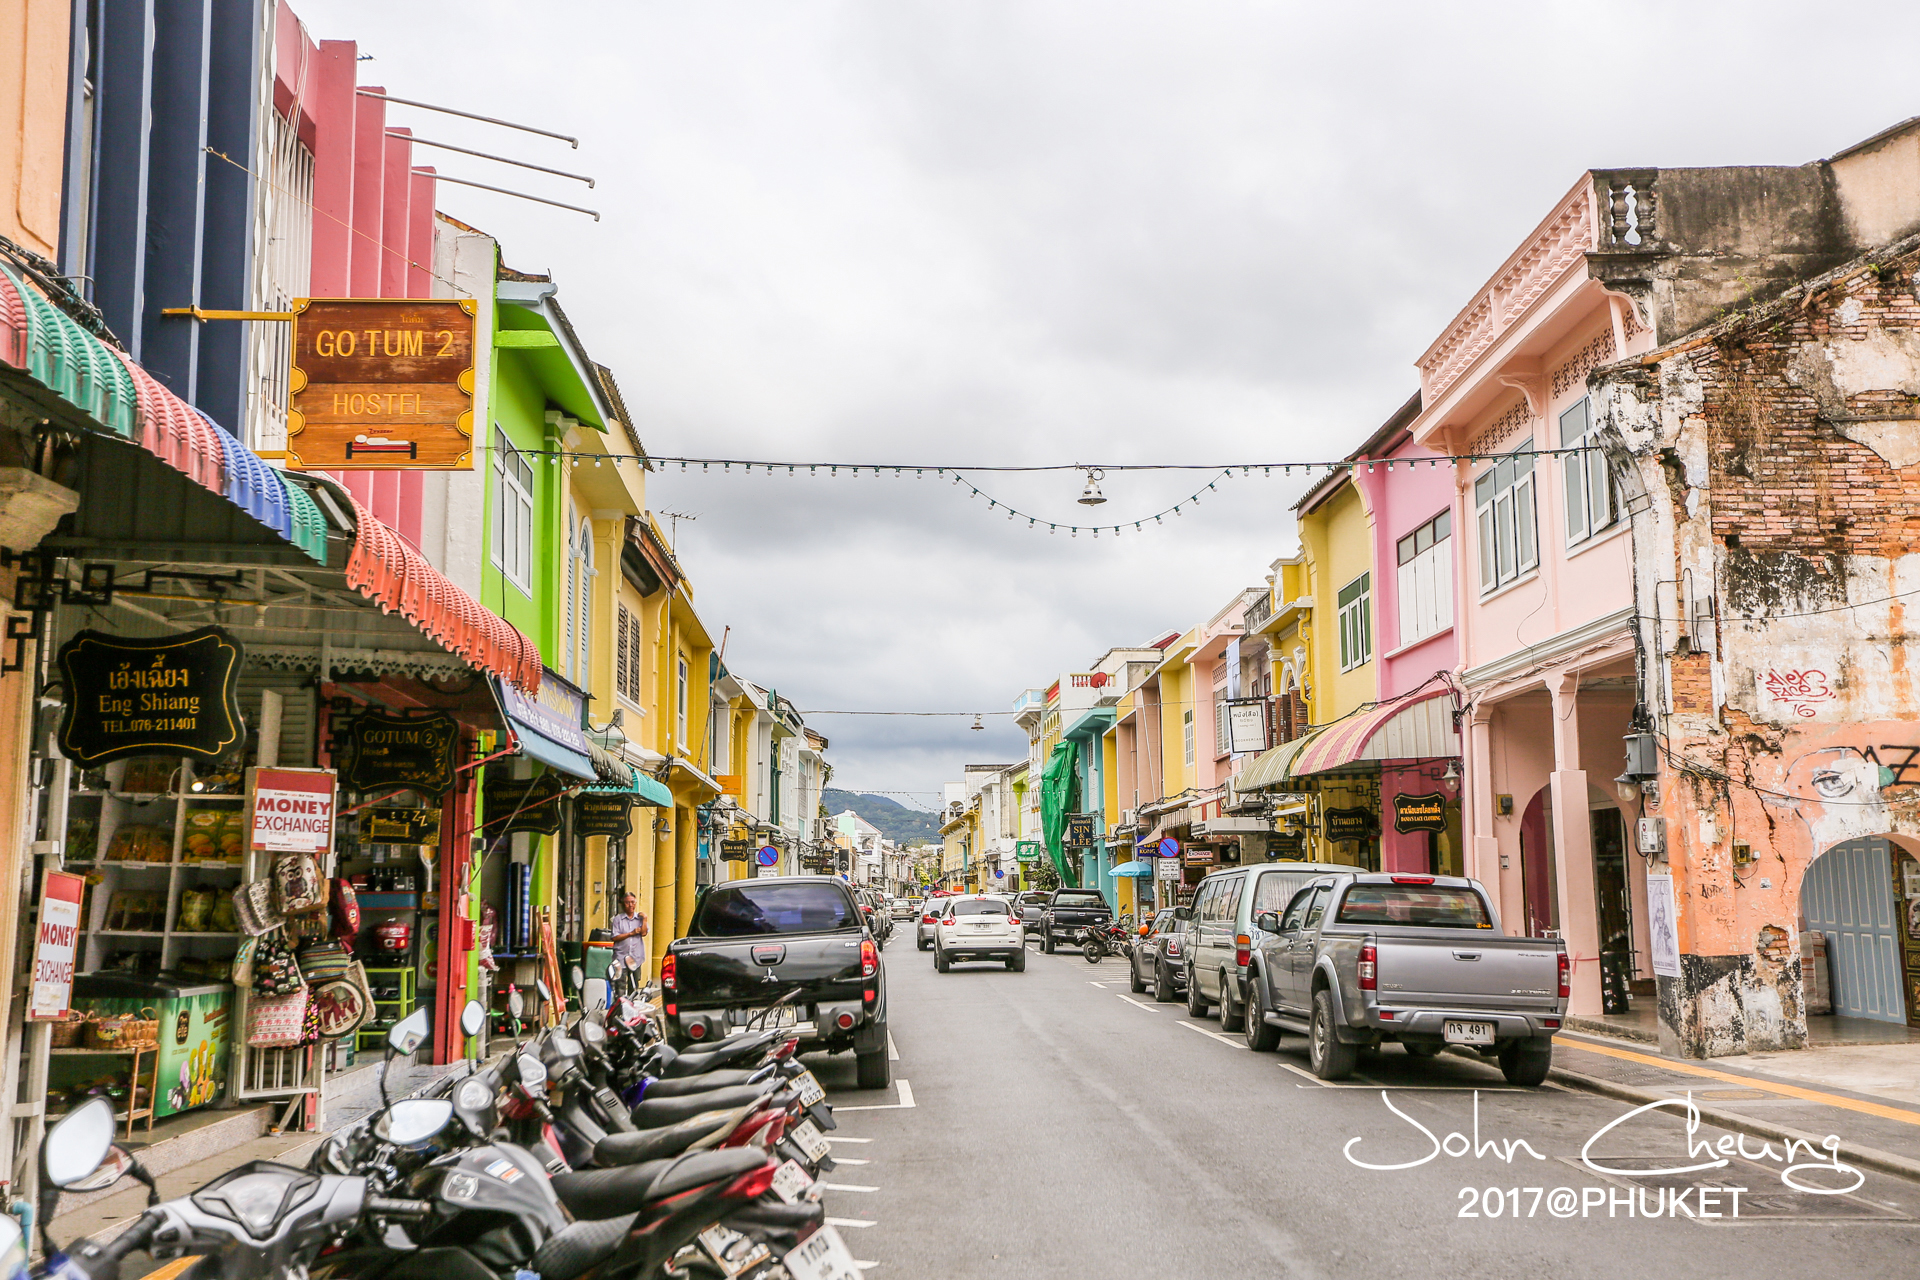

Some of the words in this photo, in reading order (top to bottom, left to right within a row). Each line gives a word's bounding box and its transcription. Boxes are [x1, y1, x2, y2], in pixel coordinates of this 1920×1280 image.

[316, 330, 355, 357] GO
[365, 330, 423, 357] TUM
[436, 330, 454, 357] 2
[333, 393, 429, 415] HOSTEL
[109, 654, 189, 690] เอ้งเฉี้ยง
[99, 695, 133, 716] Eng
[140, 693, 200, 714] Shiang
[1792, 704, 1816, 717] 16
[102, 717, 196, 733] TEL.076-211401
[364, 730, 419, 744] GOTUM
[257, 797, 331, 816] MONEY
[254, 815, 330, 834] EXCHANGE
[1073, 825, 1090, 833] SIN
[1072, 838, 1091, 846] LEE
[40, 922, 76, 947] MONEY
[35, 959, 73, 984] EXCHANGE
[1449, 1023, 1463, 1034] กจ
[1469, 1024, 1486, 1035] 491
